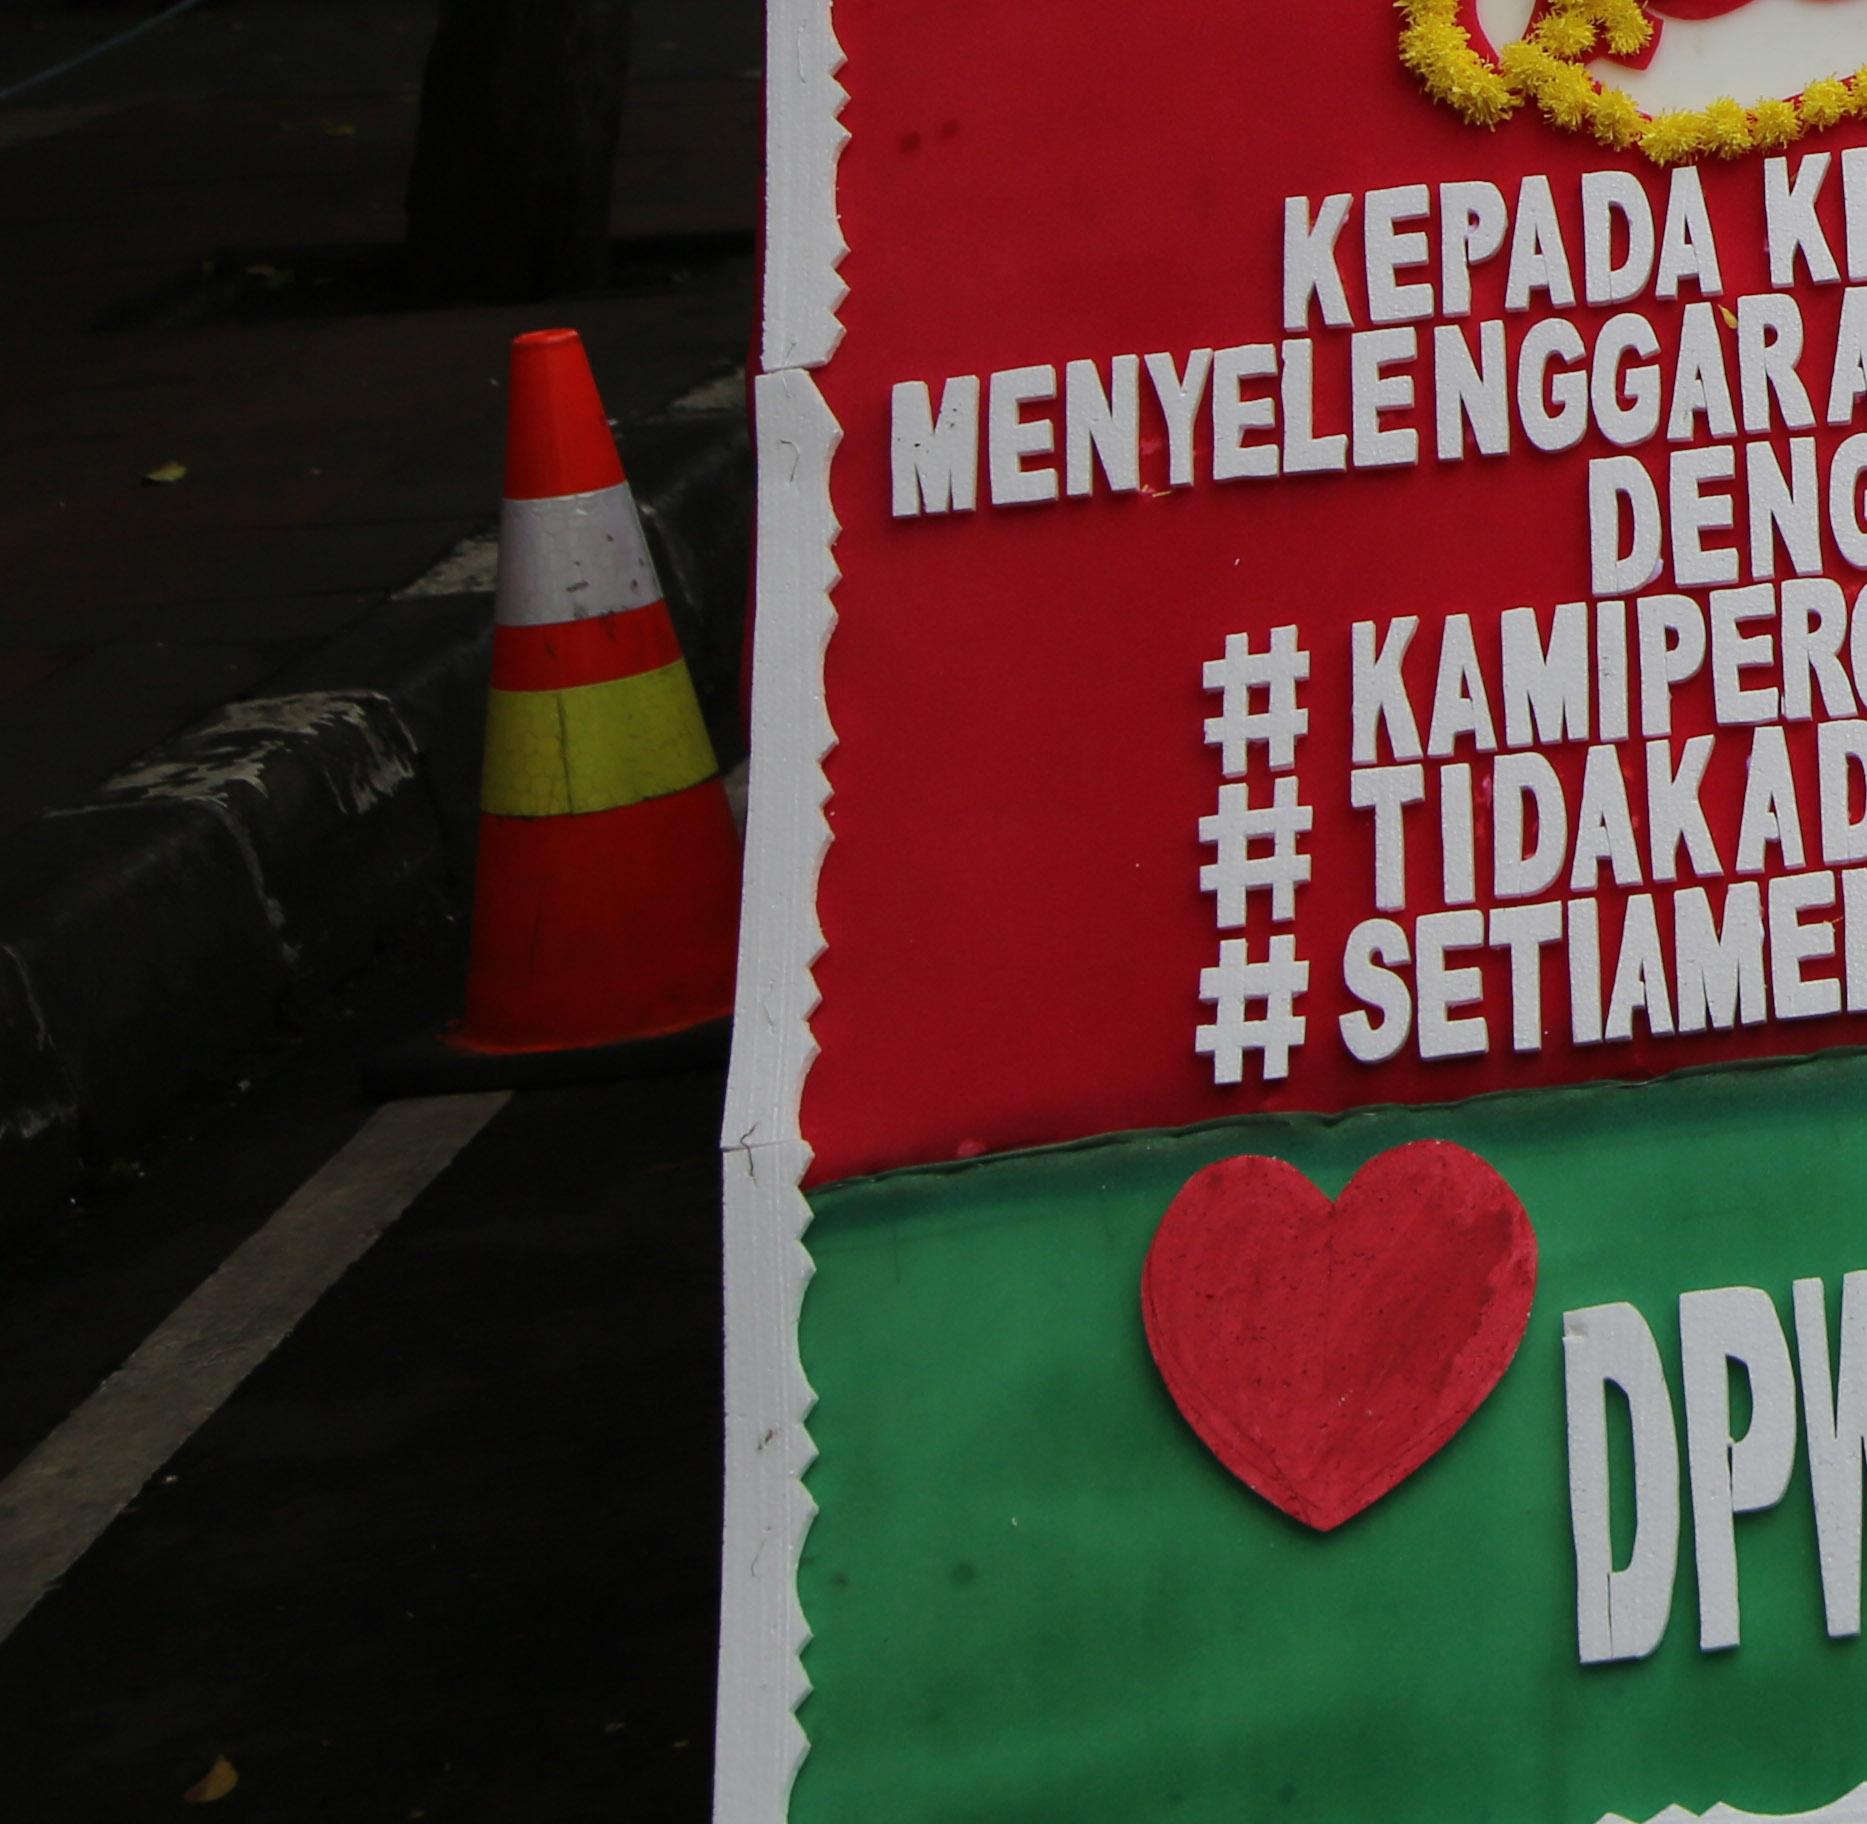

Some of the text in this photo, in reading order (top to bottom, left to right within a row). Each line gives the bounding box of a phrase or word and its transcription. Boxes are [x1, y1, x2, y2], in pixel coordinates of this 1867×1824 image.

[1284, 166, 1723, 331] KEPADA
[1201, 625, 1311, 776] #
[1196, 776, 1313, 928] #
[1195, 933, 1307, 1085] #
